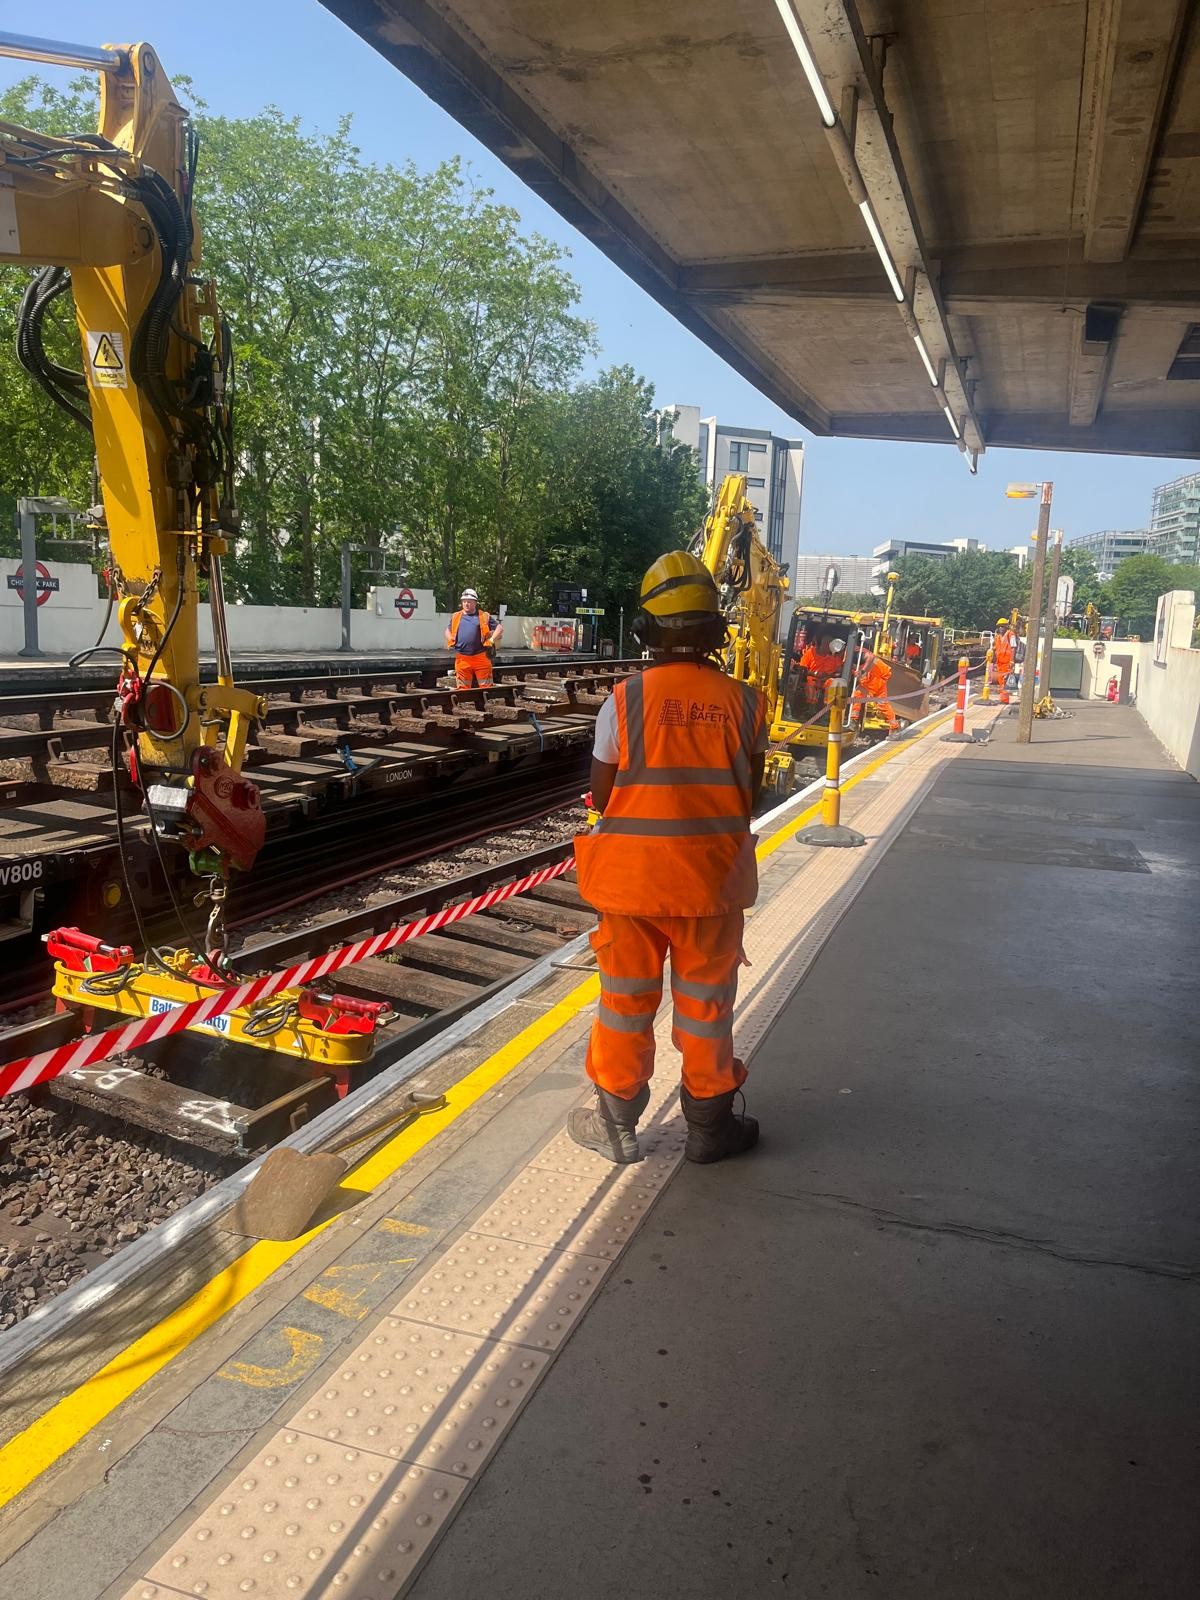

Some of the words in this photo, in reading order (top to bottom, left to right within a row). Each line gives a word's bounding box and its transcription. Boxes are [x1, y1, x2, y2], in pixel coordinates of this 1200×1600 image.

[690, 702, 705, 712] AJ
[690, 711, 730, 724] SAFETY
[385, 769, 414, 783] LONDON
